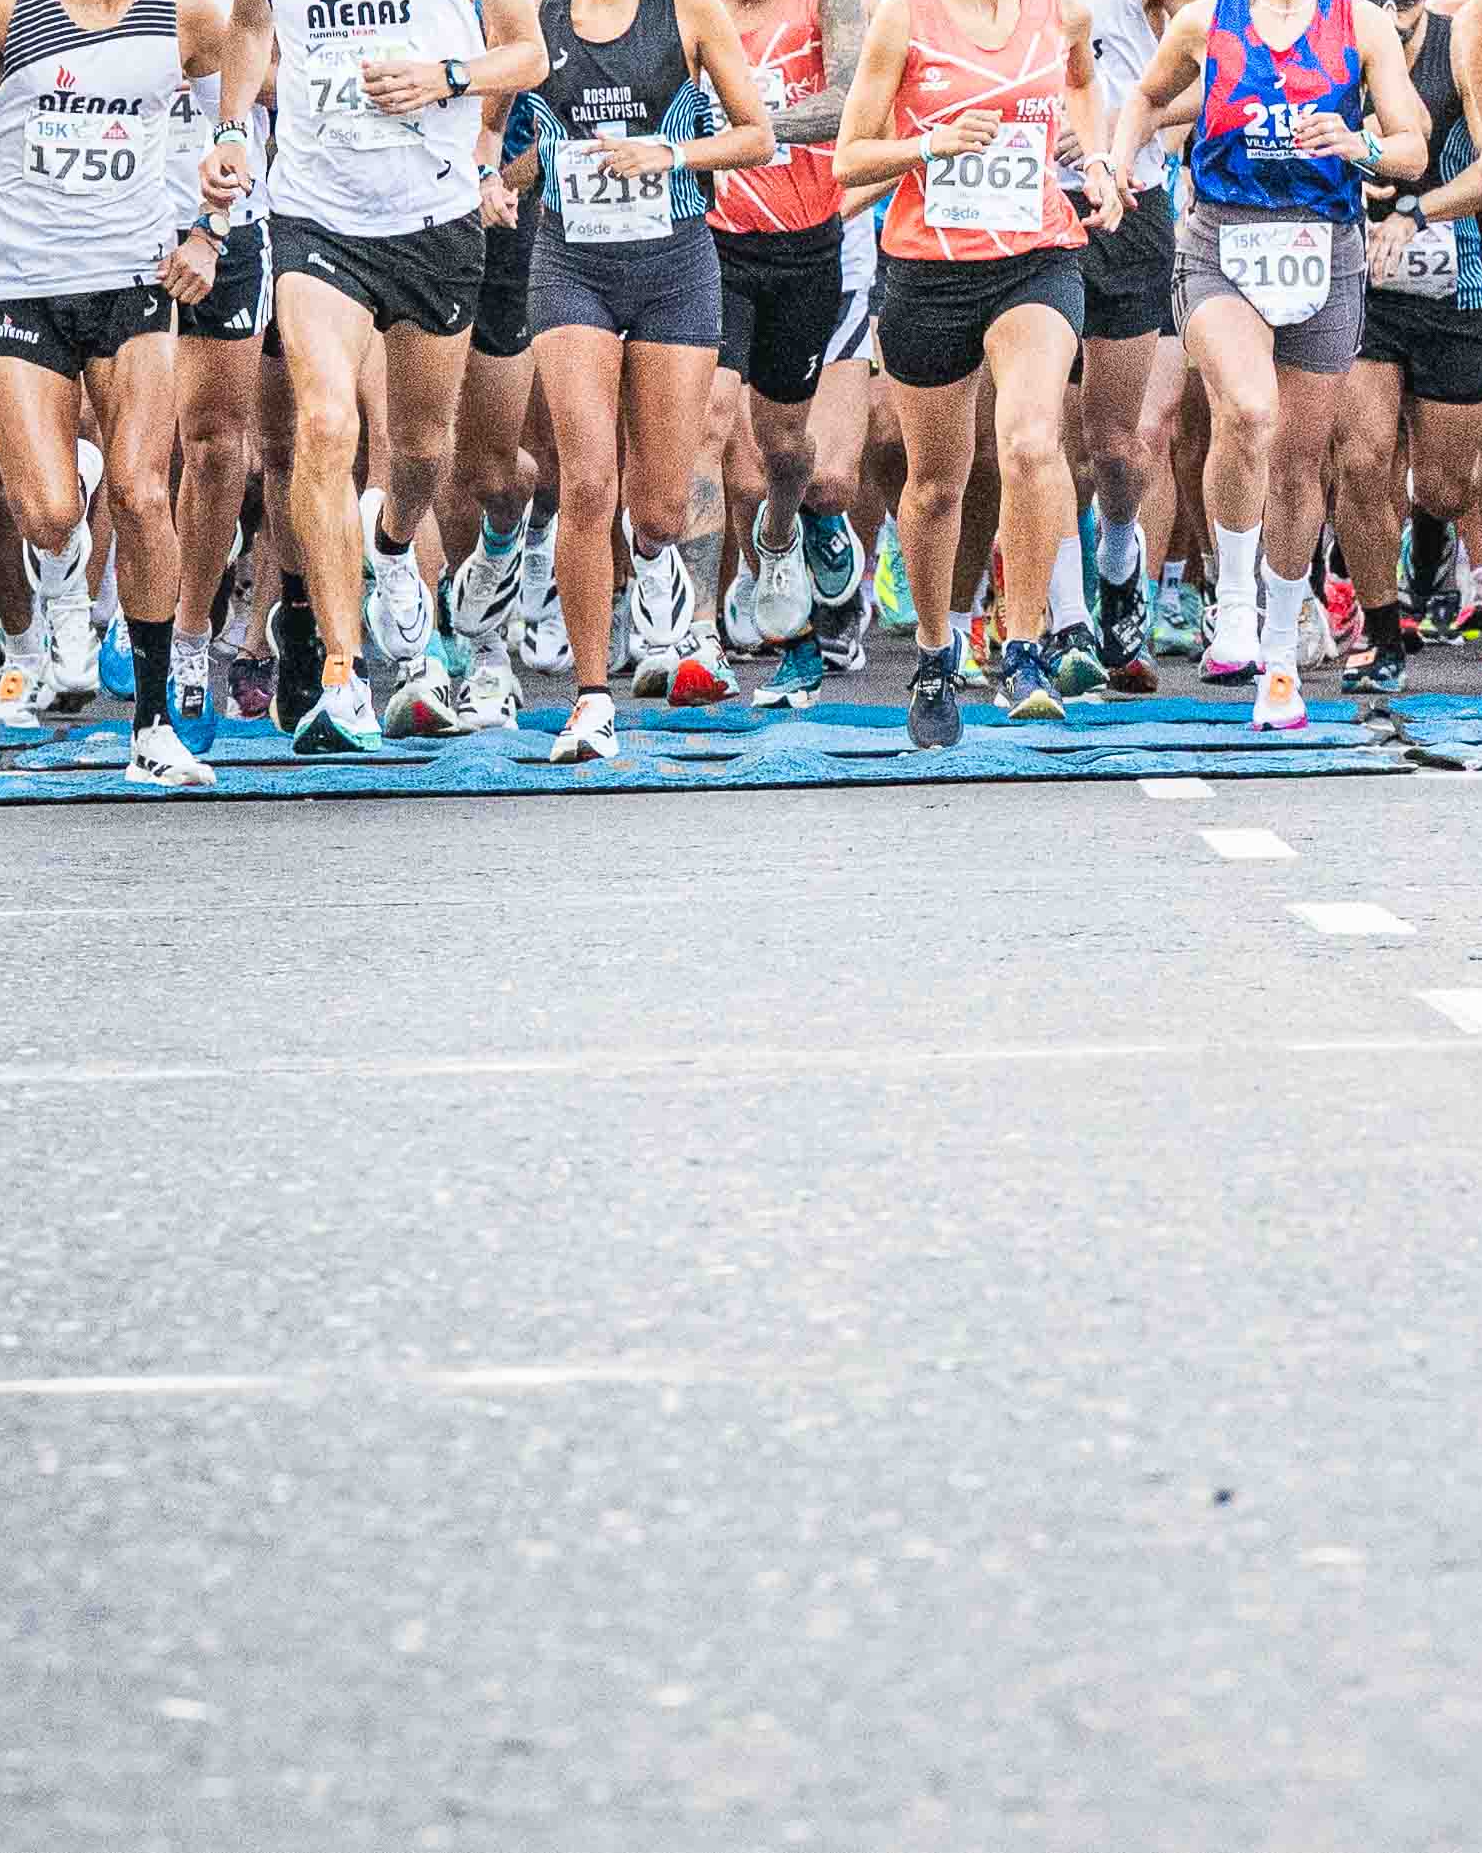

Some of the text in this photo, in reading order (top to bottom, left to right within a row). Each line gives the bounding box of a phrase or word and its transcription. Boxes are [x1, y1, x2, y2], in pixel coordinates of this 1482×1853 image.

[309, 28, 376, 39] running team
[583, 86, 632, 104] ROSARIO
[570, 102, 648, 122] CALLEYPISTA
[37, 121, 69, 139] 15K
[1245, 137, 1278, 149] VILLA
[29, 145, 136, 182] 1750
[932, 154, 1039, 189] 2062
[564, 171, 664, 205] 1218
[1226, 254, 1326, 288] 2100
